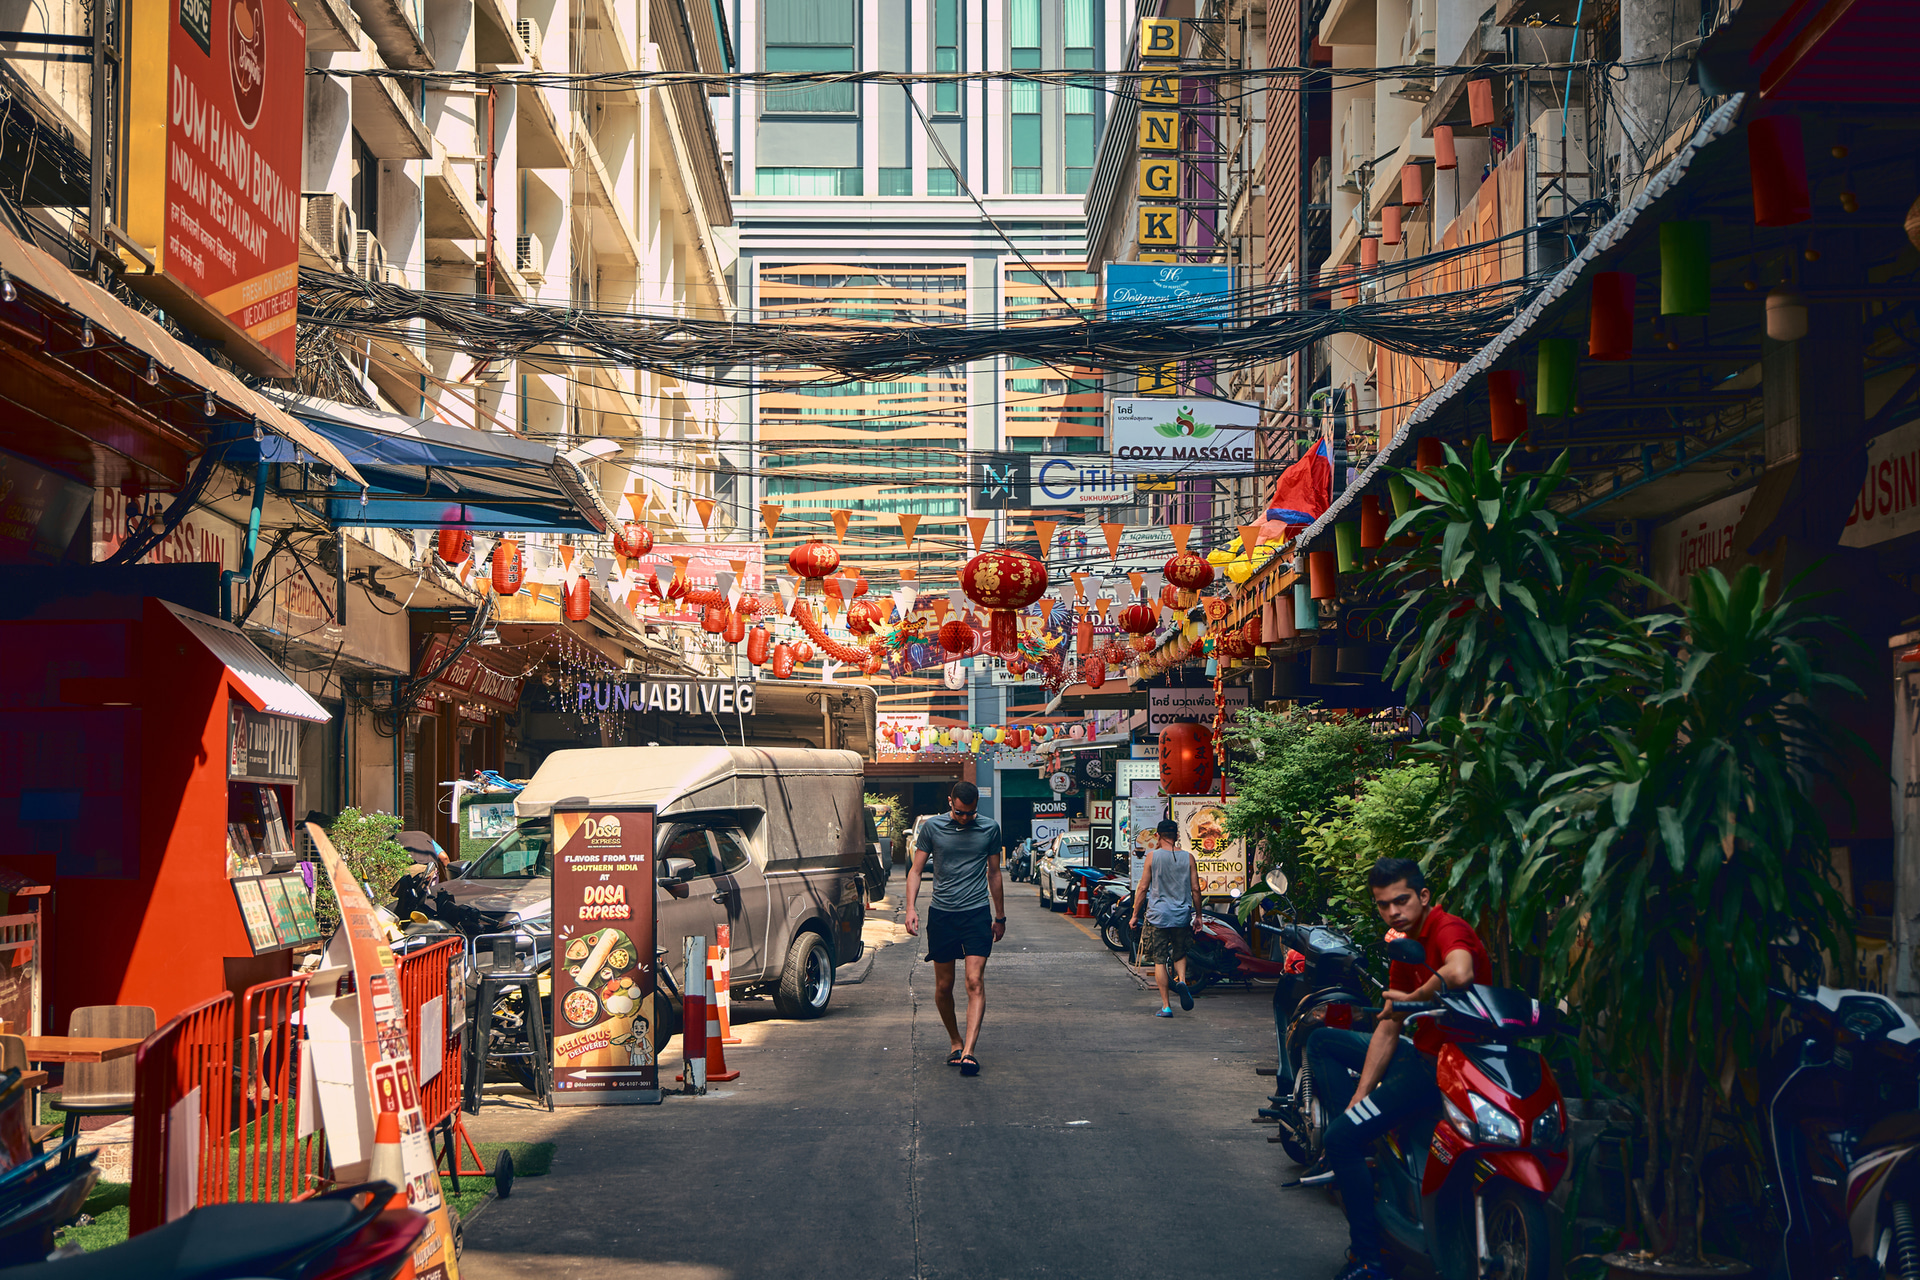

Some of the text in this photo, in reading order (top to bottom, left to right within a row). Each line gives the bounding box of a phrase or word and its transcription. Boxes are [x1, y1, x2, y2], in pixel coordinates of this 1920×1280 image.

[173, 64, 207, 153] DUM
[210, 104, 251, 197] HANDI
[253, 151, 297, 243] BIRYANI
[1144, 24, 1175, 262] BANGK
[171, 141, 267, 264] INDIAN RESTAURANT
[242, 269, 294, 304] FRESH ON ORDER
[243, 306, 253, 327] WE
[1117, 404, 1133, 415] โคซี่
[1118, 446, 1254, 460] COZY MASSAGE
[1846, 450, 1920, 527] USIN
[578, 683, 753, 713] PUNJABI VEG
[268, 717, 298, 776] PIZZA
[1034, 803, 1067, 812] ROOMS
[584, 818, 622, 839] Dosa
[1191, 839, 1203, 850] 天
[1216, 838, 1228, 850] 洋
[1211, 861, 1243, 872] TENYO
[584, 885, 624, 905] DOSA
[579, 905, 630, 920] EXPRESS
[556, 1030, 612, 1056] DELICIOUS
[568, 1040, 609, 1059] DELIVERED
